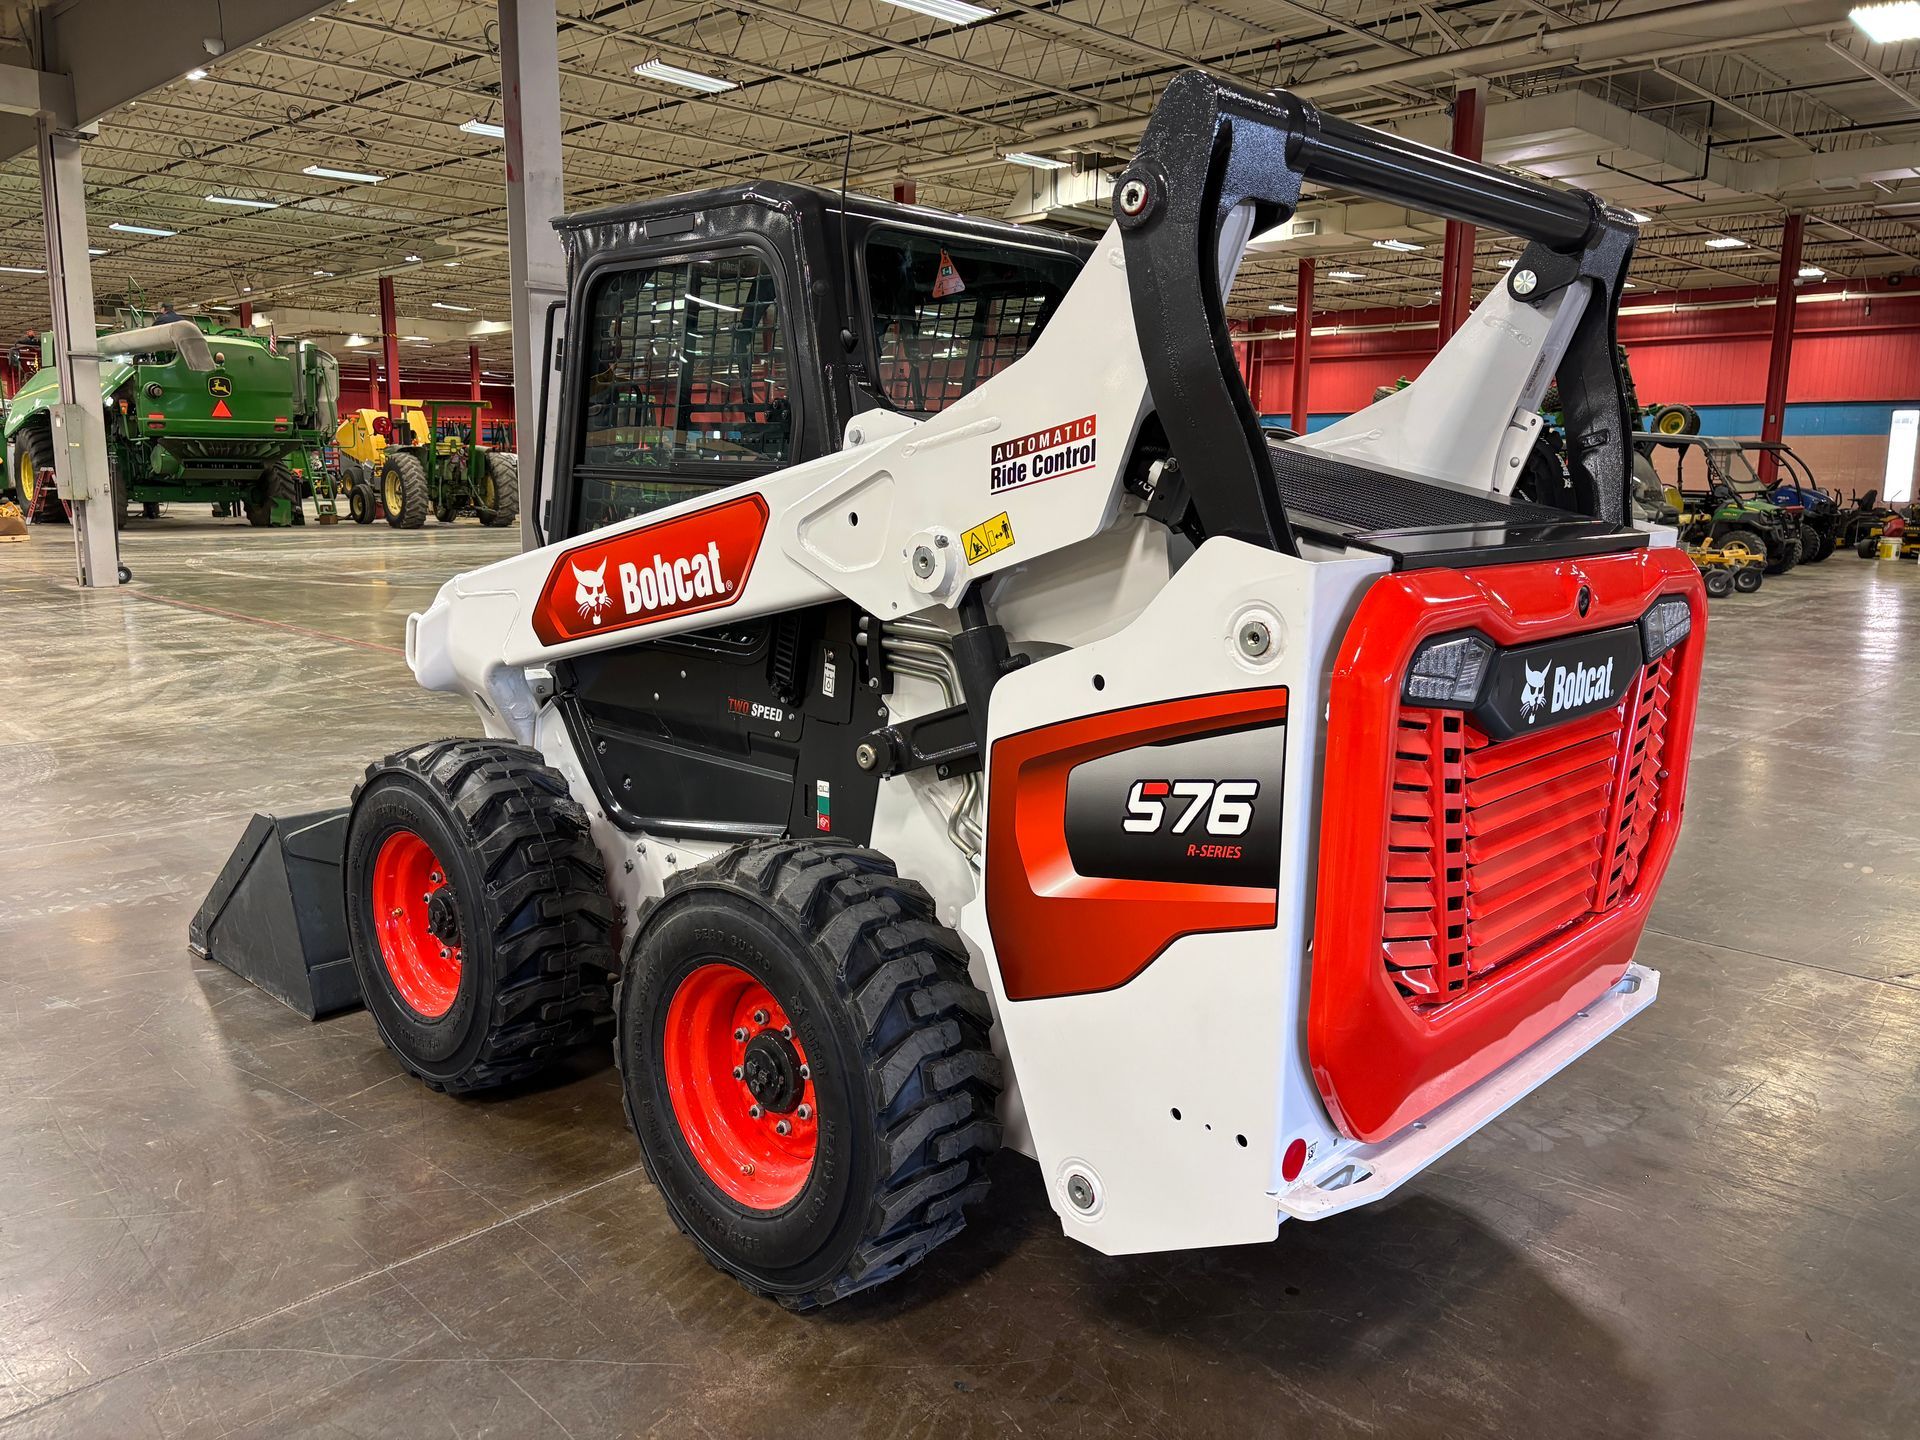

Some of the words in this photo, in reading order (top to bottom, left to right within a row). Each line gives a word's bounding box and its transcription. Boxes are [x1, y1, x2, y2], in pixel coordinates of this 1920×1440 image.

[991, 461, 1027, 490] Ride
[1032, 438, 1096, 478] Control
[995, 419, 1092, 462] AUTOMATIC
[619, 541, 725, 615] Bobcat
[728, 698, 750, 714] TWO
[751, 703, 783, 722] SPEED
[1551, 656, 1614, 714] Bobcat
[1122, 780, 1258, 835] S76
[1187, 844, 1242, 859] R-SERIES
